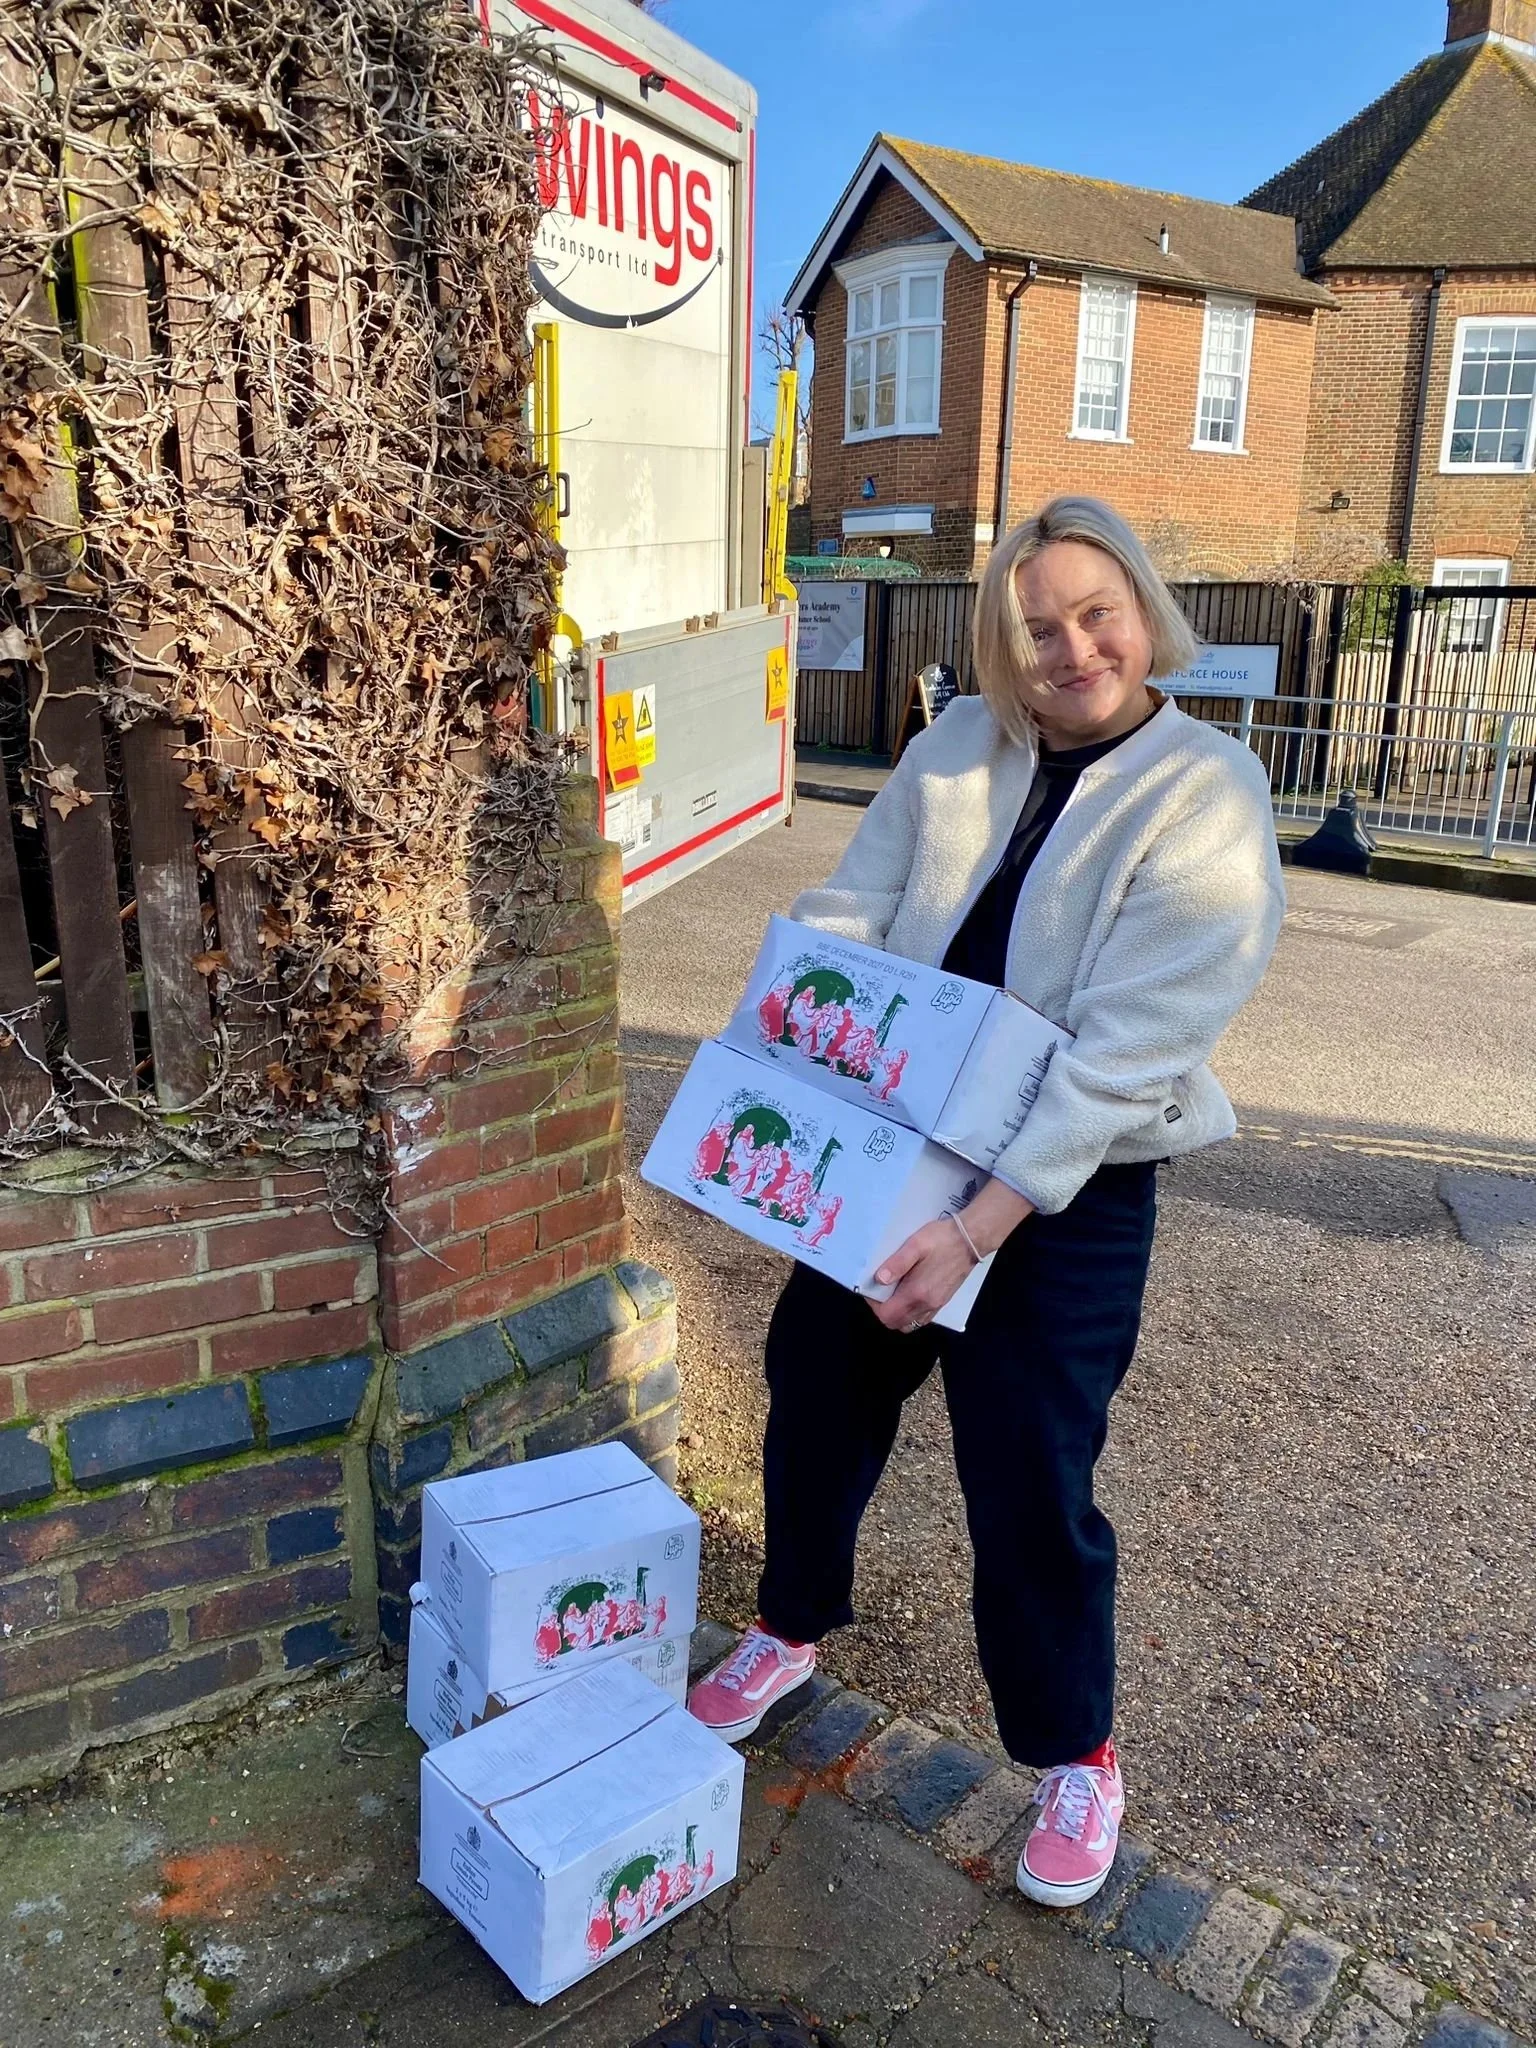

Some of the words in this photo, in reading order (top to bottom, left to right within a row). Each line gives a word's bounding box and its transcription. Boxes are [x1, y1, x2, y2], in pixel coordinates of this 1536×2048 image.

[541, 227, 621, 270] transport
[628, 253, 648, 277] ltd
[809, 601, 840, 613] Academy
[812, 615, 831, 623] School
[1212, 669, 1249, 680] HOUSE
[830, 946, 867, 965] DECEMBER
[931, 985, 964, 1009] Lupa
[862, 1129, 895, 1156] Lupa
